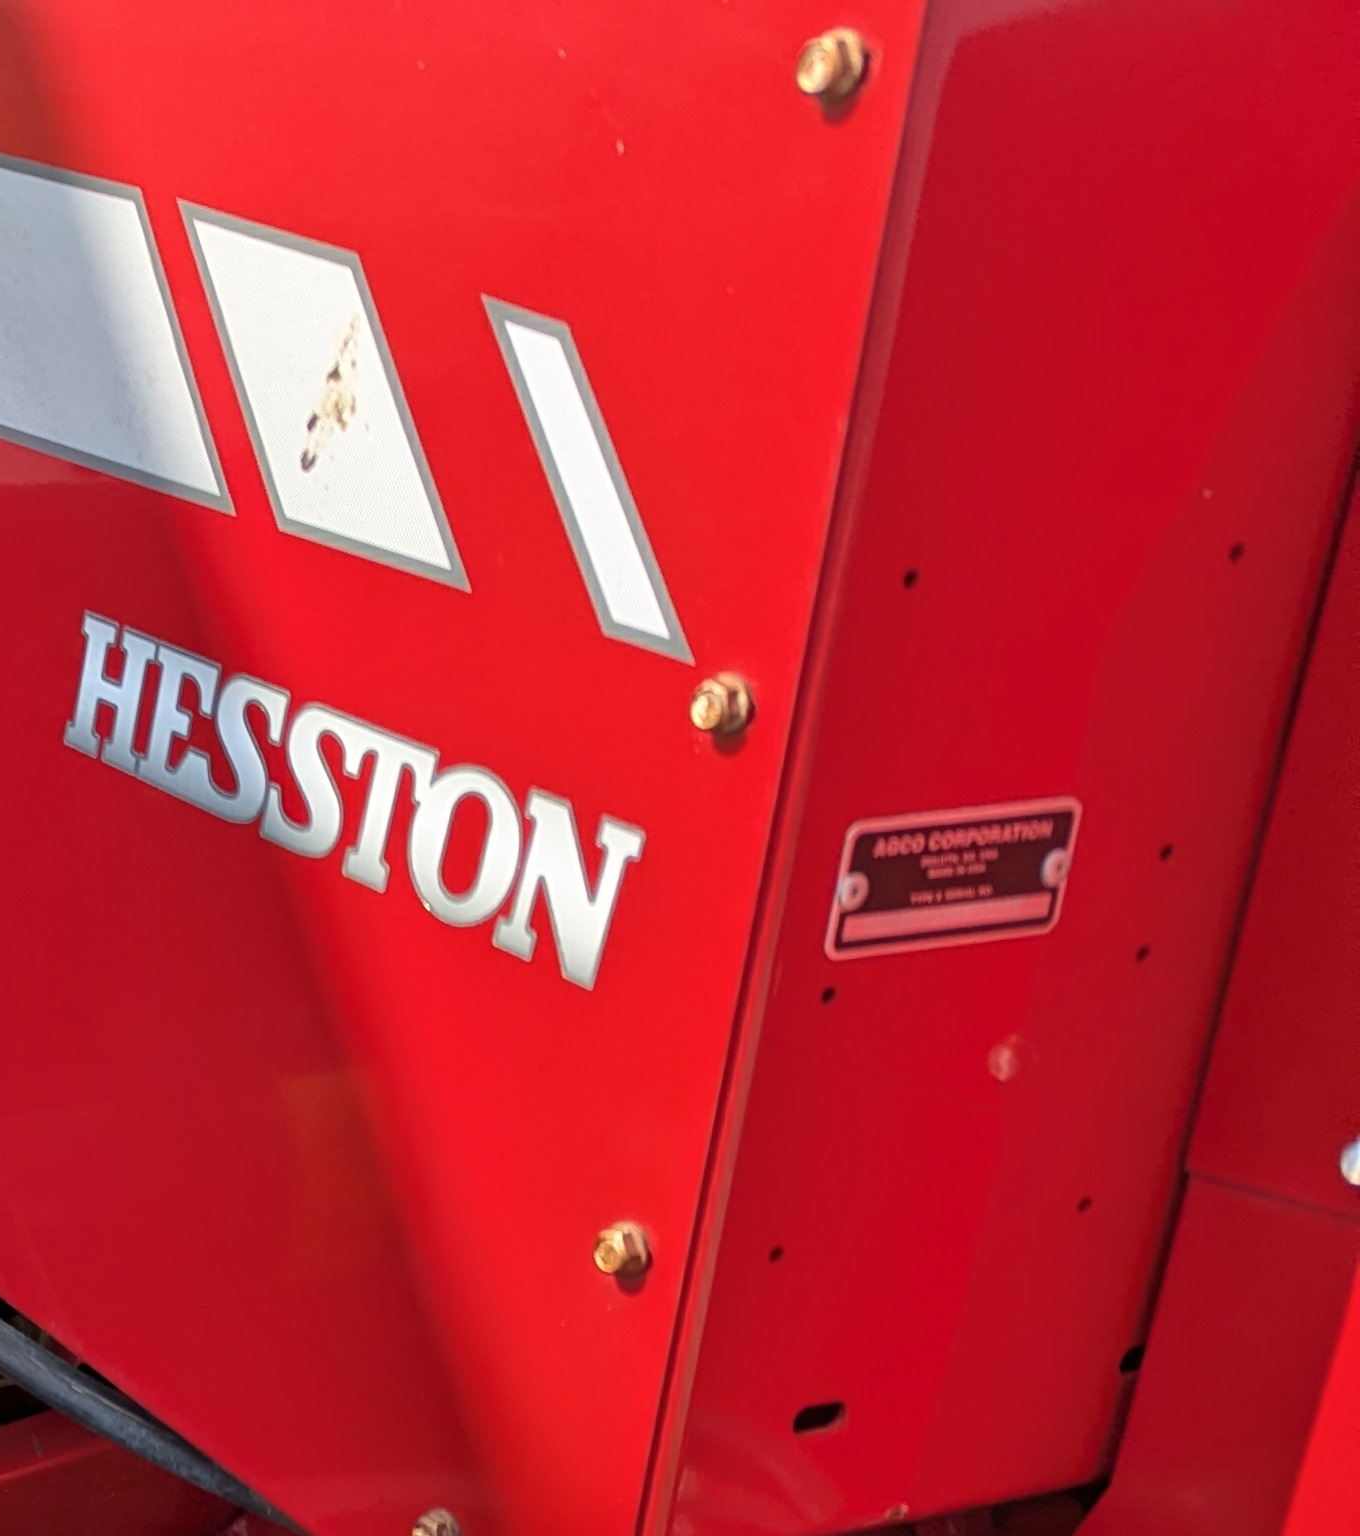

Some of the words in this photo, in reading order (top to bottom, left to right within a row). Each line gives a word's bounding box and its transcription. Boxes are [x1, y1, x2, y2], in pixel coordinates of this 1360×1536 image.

[63, 609, 647, 991] HESSTON
[873, 833, 925, 858] AGCO
[929, 820, 1054, 851] CORPORATION
